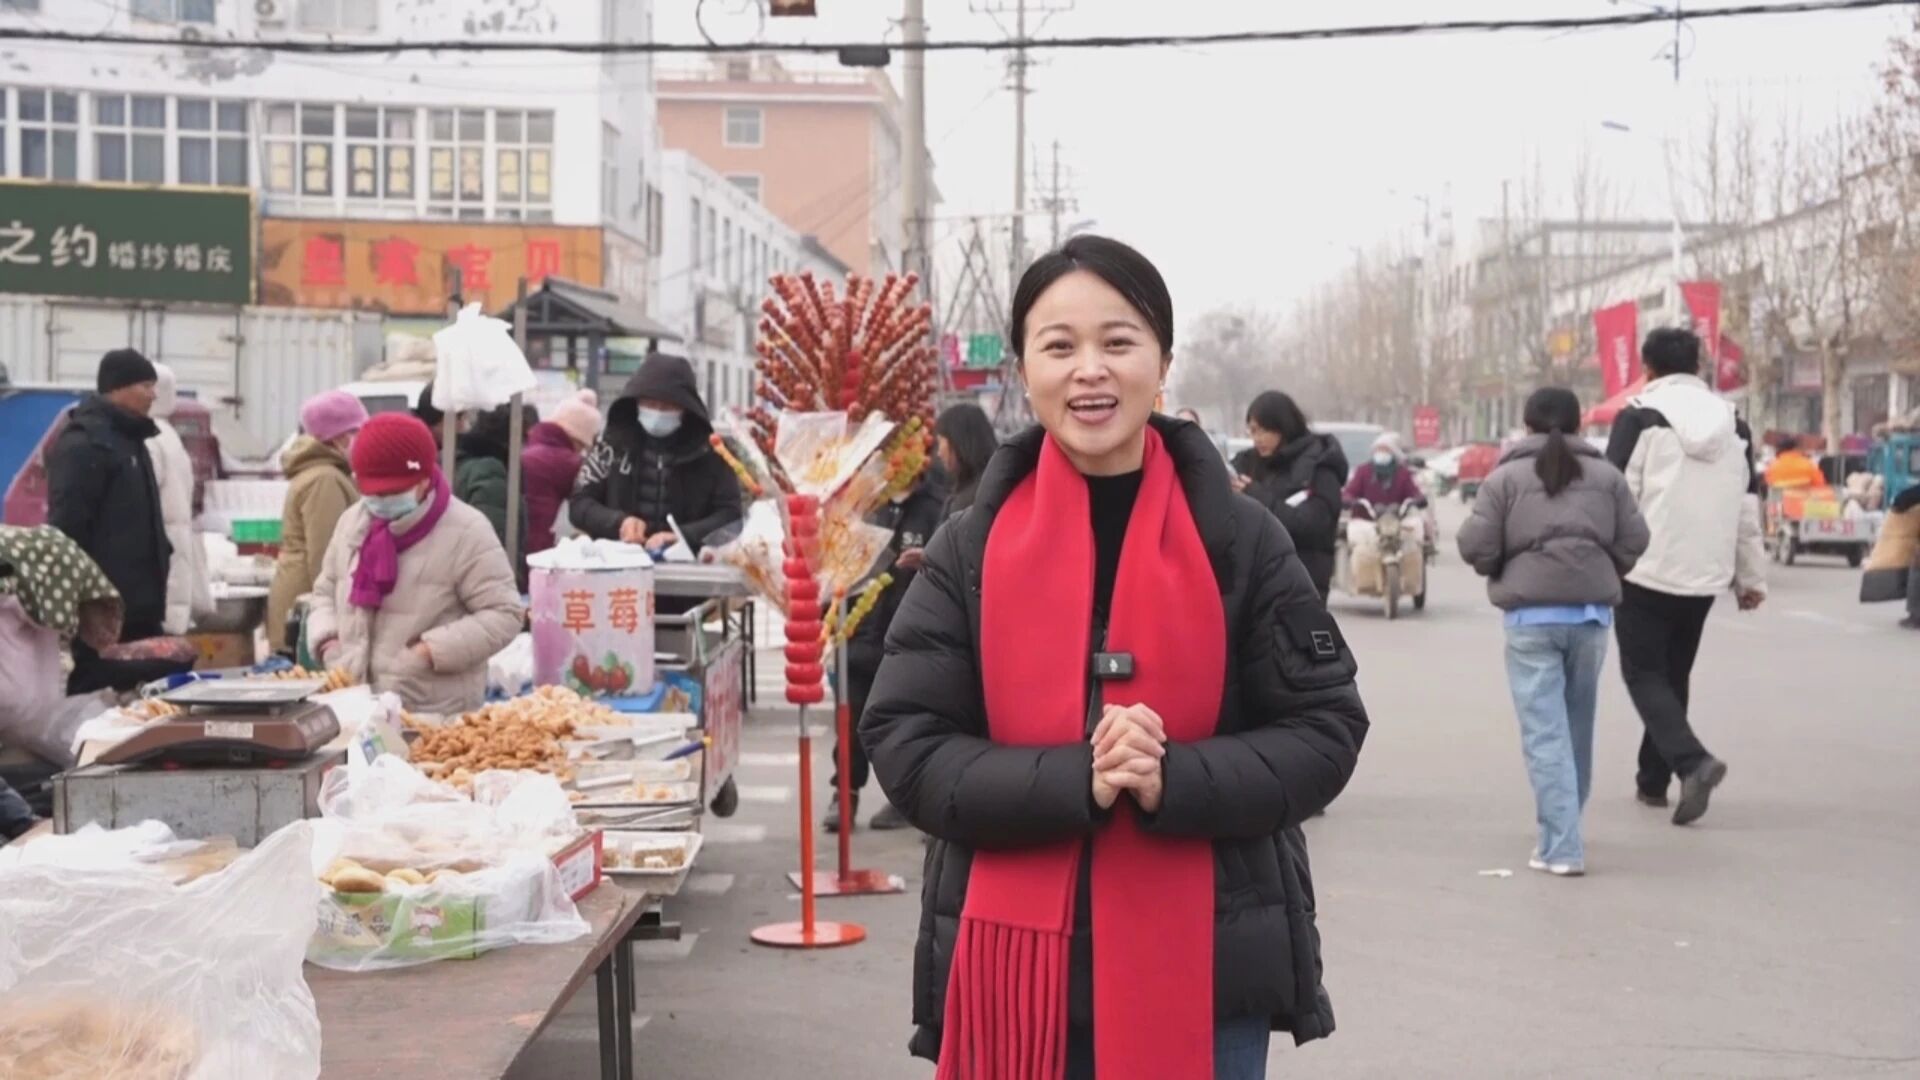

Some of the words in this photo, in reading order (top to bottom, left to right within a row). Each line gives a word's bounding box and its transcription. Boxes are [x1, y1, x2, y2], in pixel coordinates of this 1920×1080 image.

[0, 220, 98, 268] 之约
[108, 241, 234, 273] 婚纱婚庆
